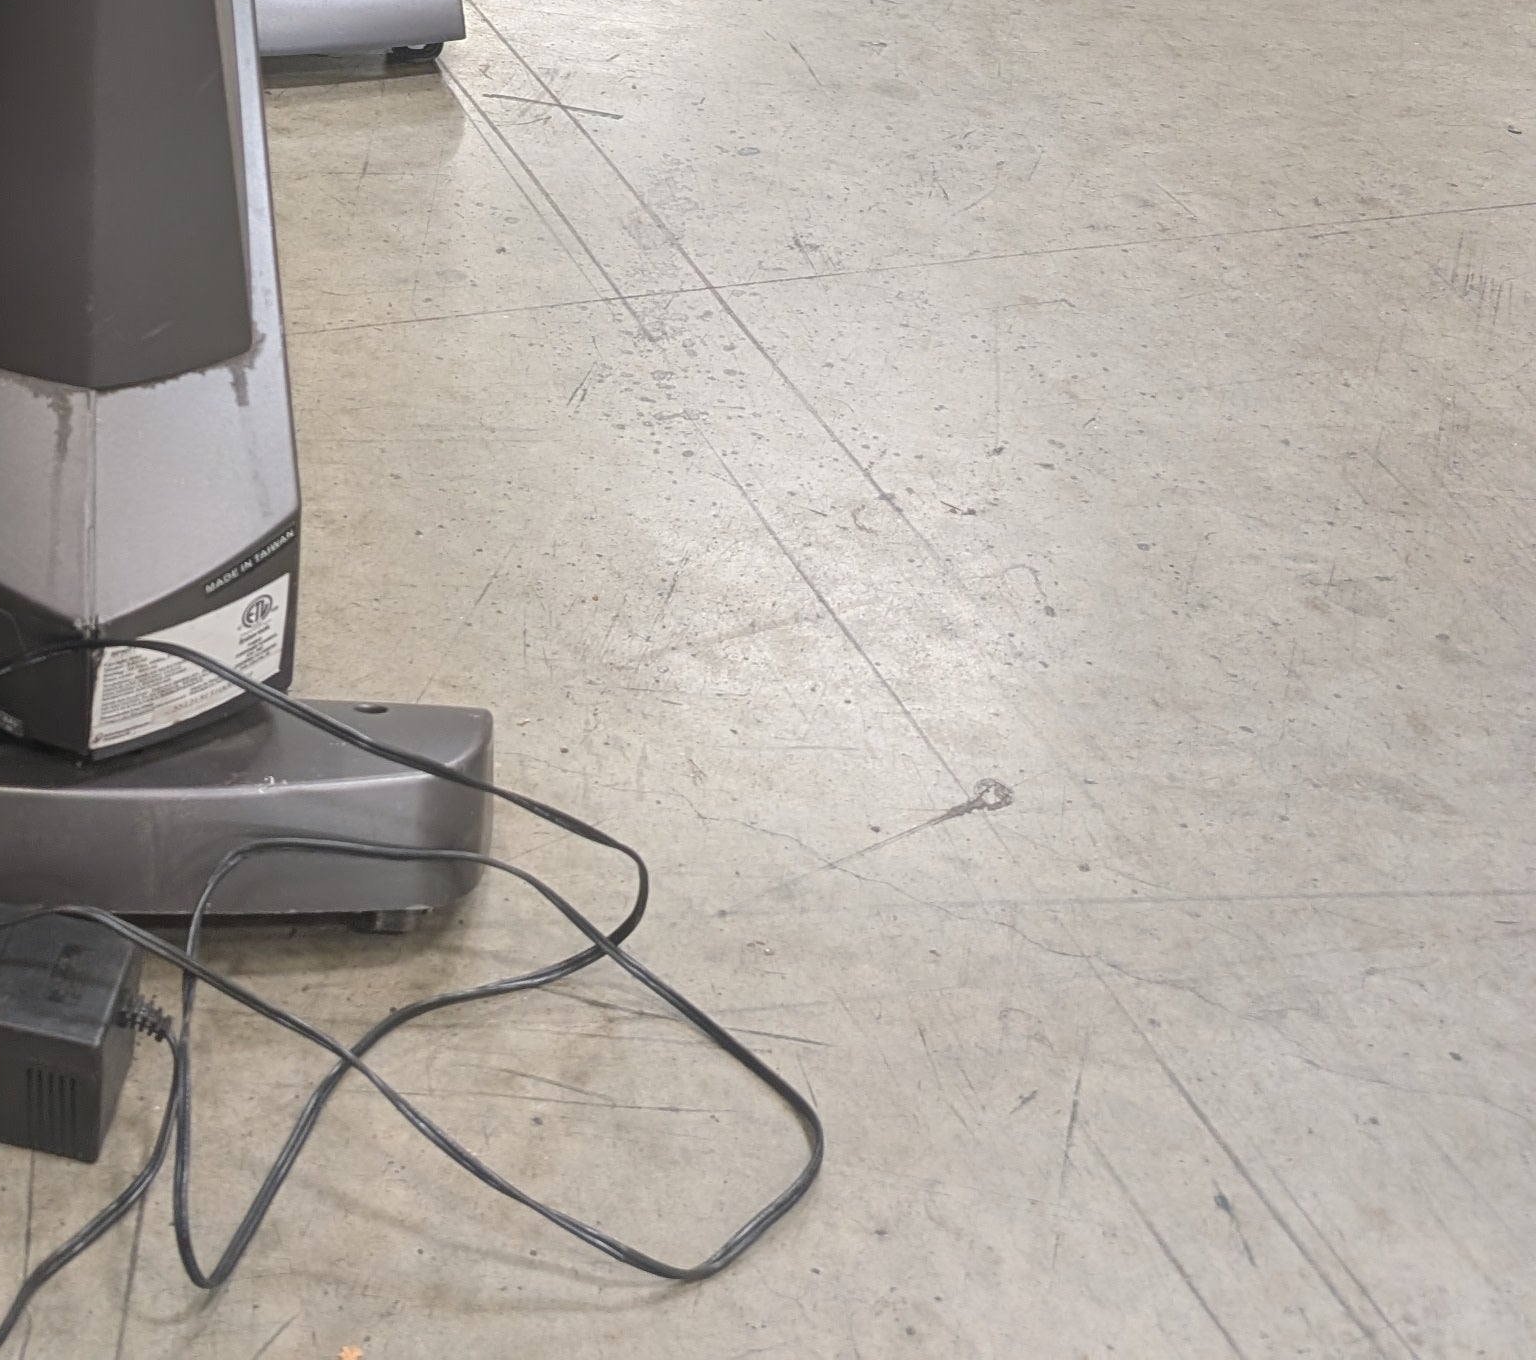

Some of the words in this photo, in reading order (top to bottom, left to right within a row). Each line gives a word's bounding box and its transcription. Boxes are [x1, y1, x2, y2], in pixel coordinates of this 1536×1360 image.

[205, 567, 239, 594] MADE
[240, 558, 253, 574] IN
[254, 528, 295, 563] TAIWAN
